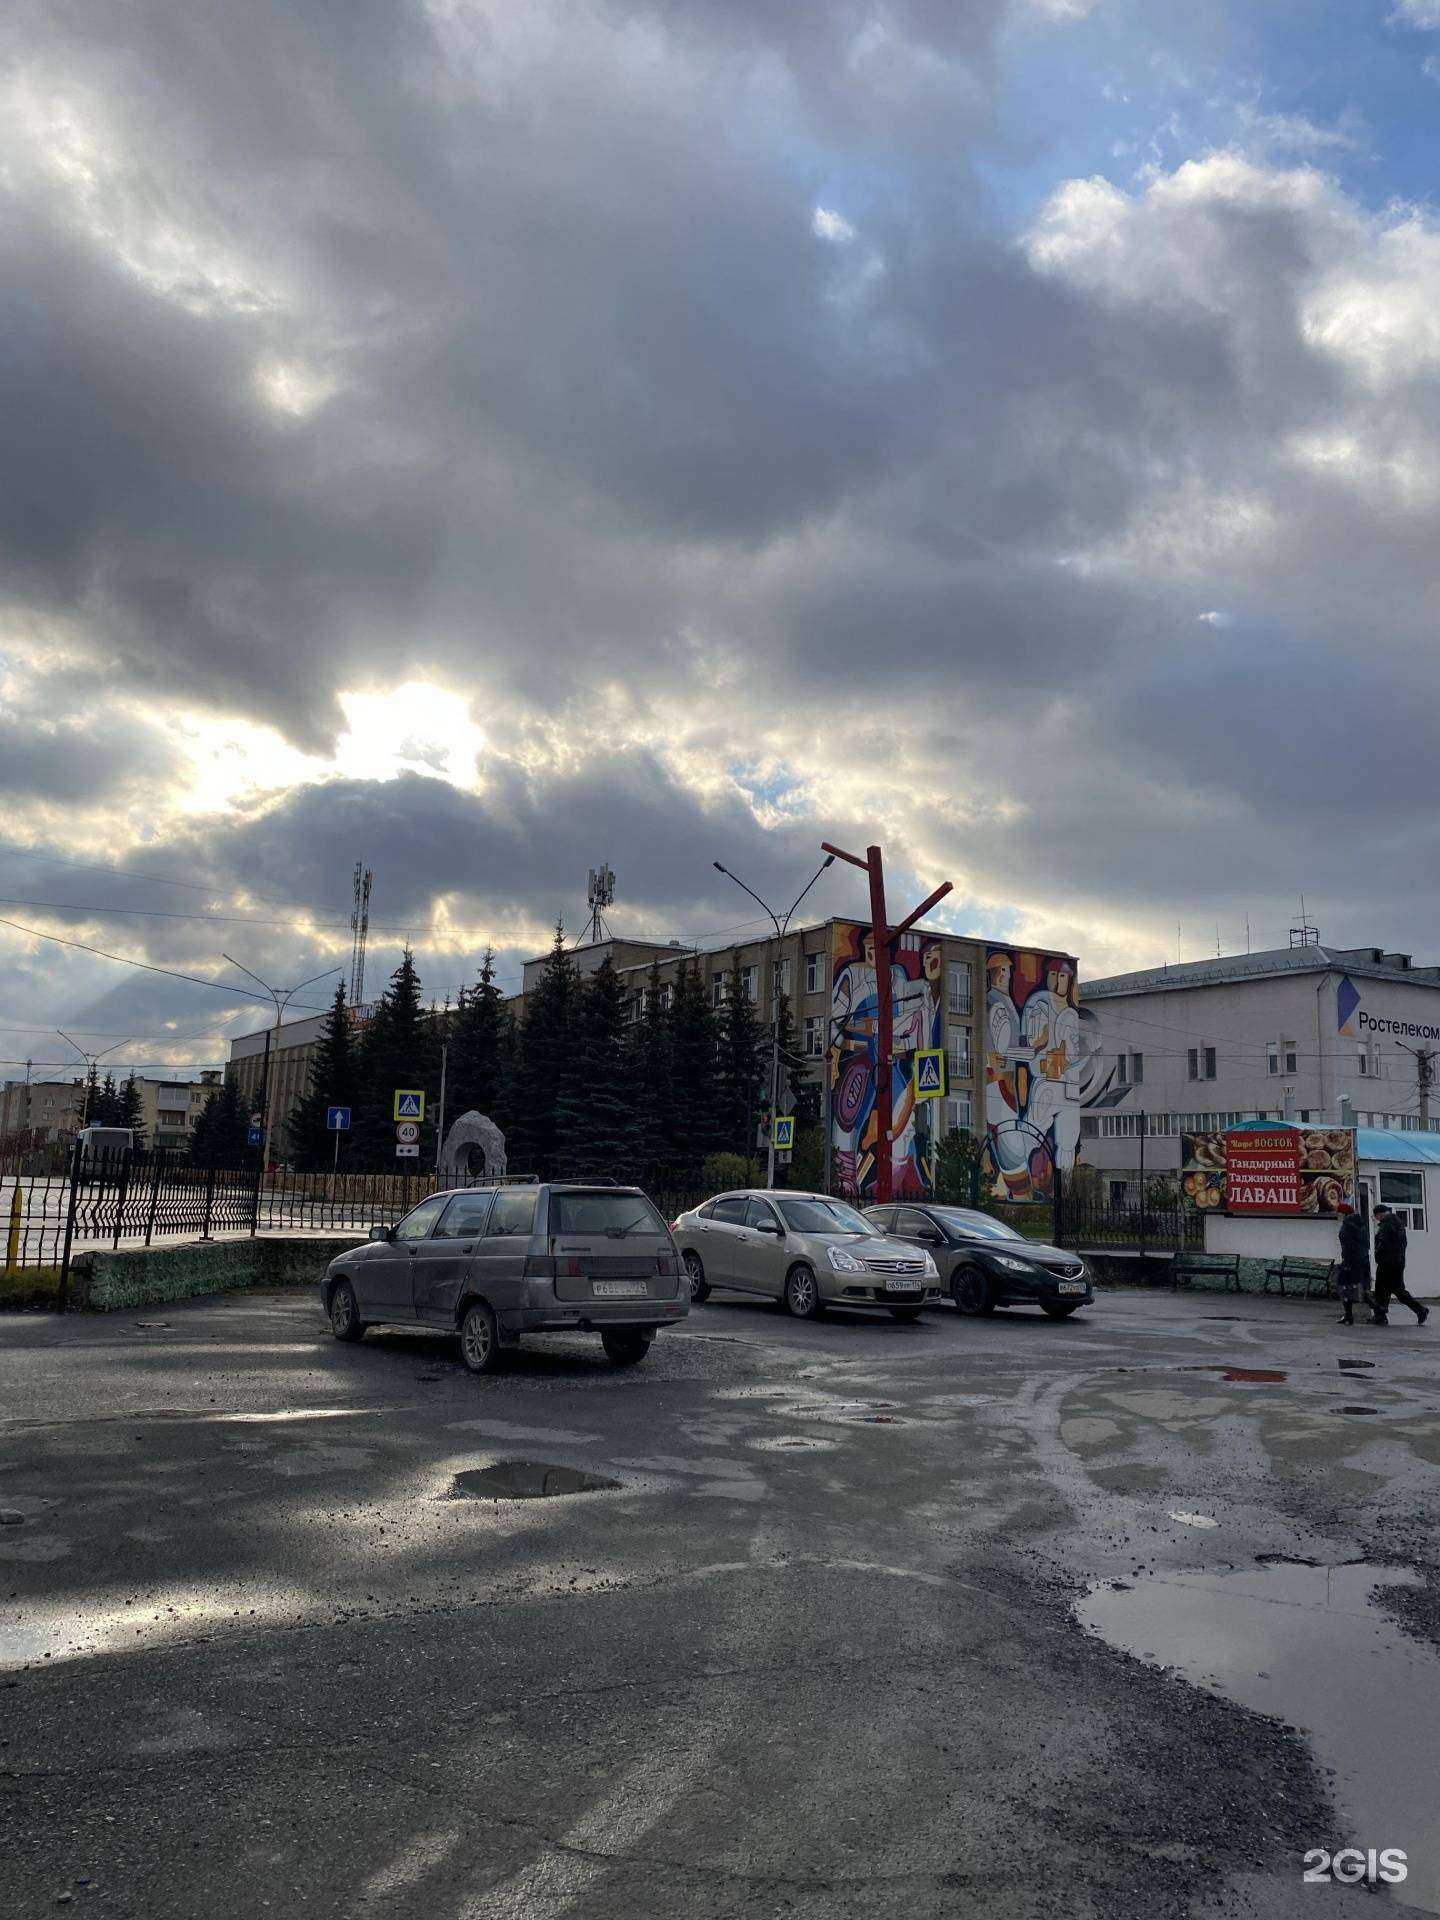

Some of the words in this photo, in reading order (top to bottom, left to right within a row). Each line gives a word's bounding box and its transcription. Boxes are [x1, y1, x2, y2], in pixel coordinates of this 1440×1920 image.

[1359, 1011, 1440, 1040] Ростелеком
[402, 1127, 415, 1137] 40
[1254, 1138, 1293, 1149] ВОСТОК
[1231, 1158, 1295, 1170] Тандырный
[1229, 1172, 1297, 1184] Таджикский
[1230, 1187, 1298, 1204] ЛАВАШ
